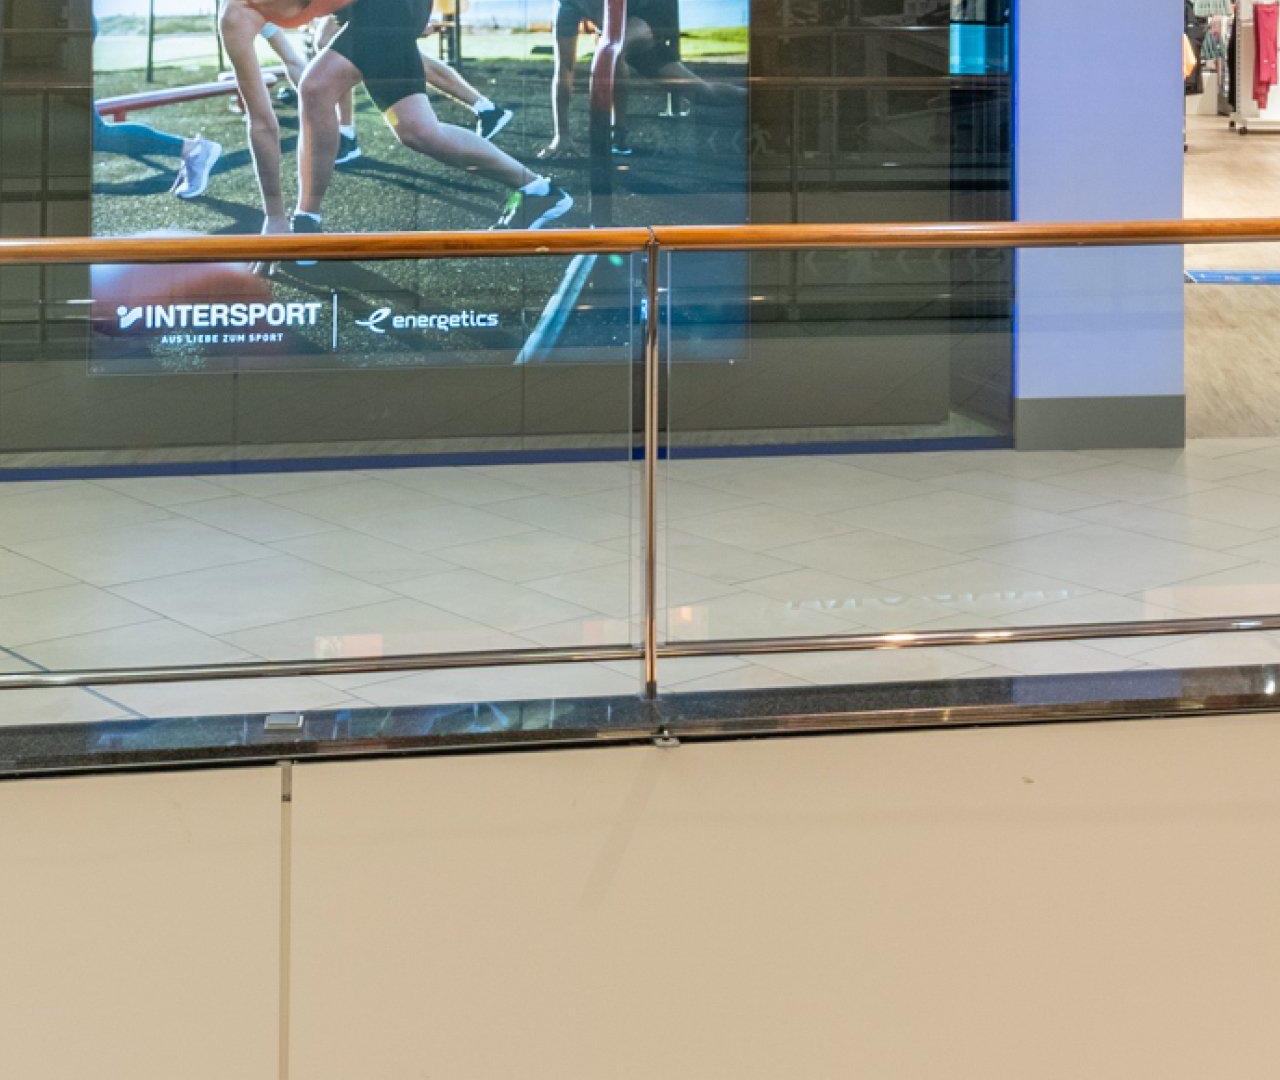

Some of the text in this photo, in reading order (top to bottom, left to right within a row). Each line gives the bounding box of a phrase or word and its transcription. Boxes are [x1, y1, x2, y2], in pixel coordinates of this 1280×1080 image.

[145, 302, 323, 329] INTERSPORT
[392, 310, 499, 331] energetics
[161, 333, 284, 344] AUS LIEBE ZUM SPORT
